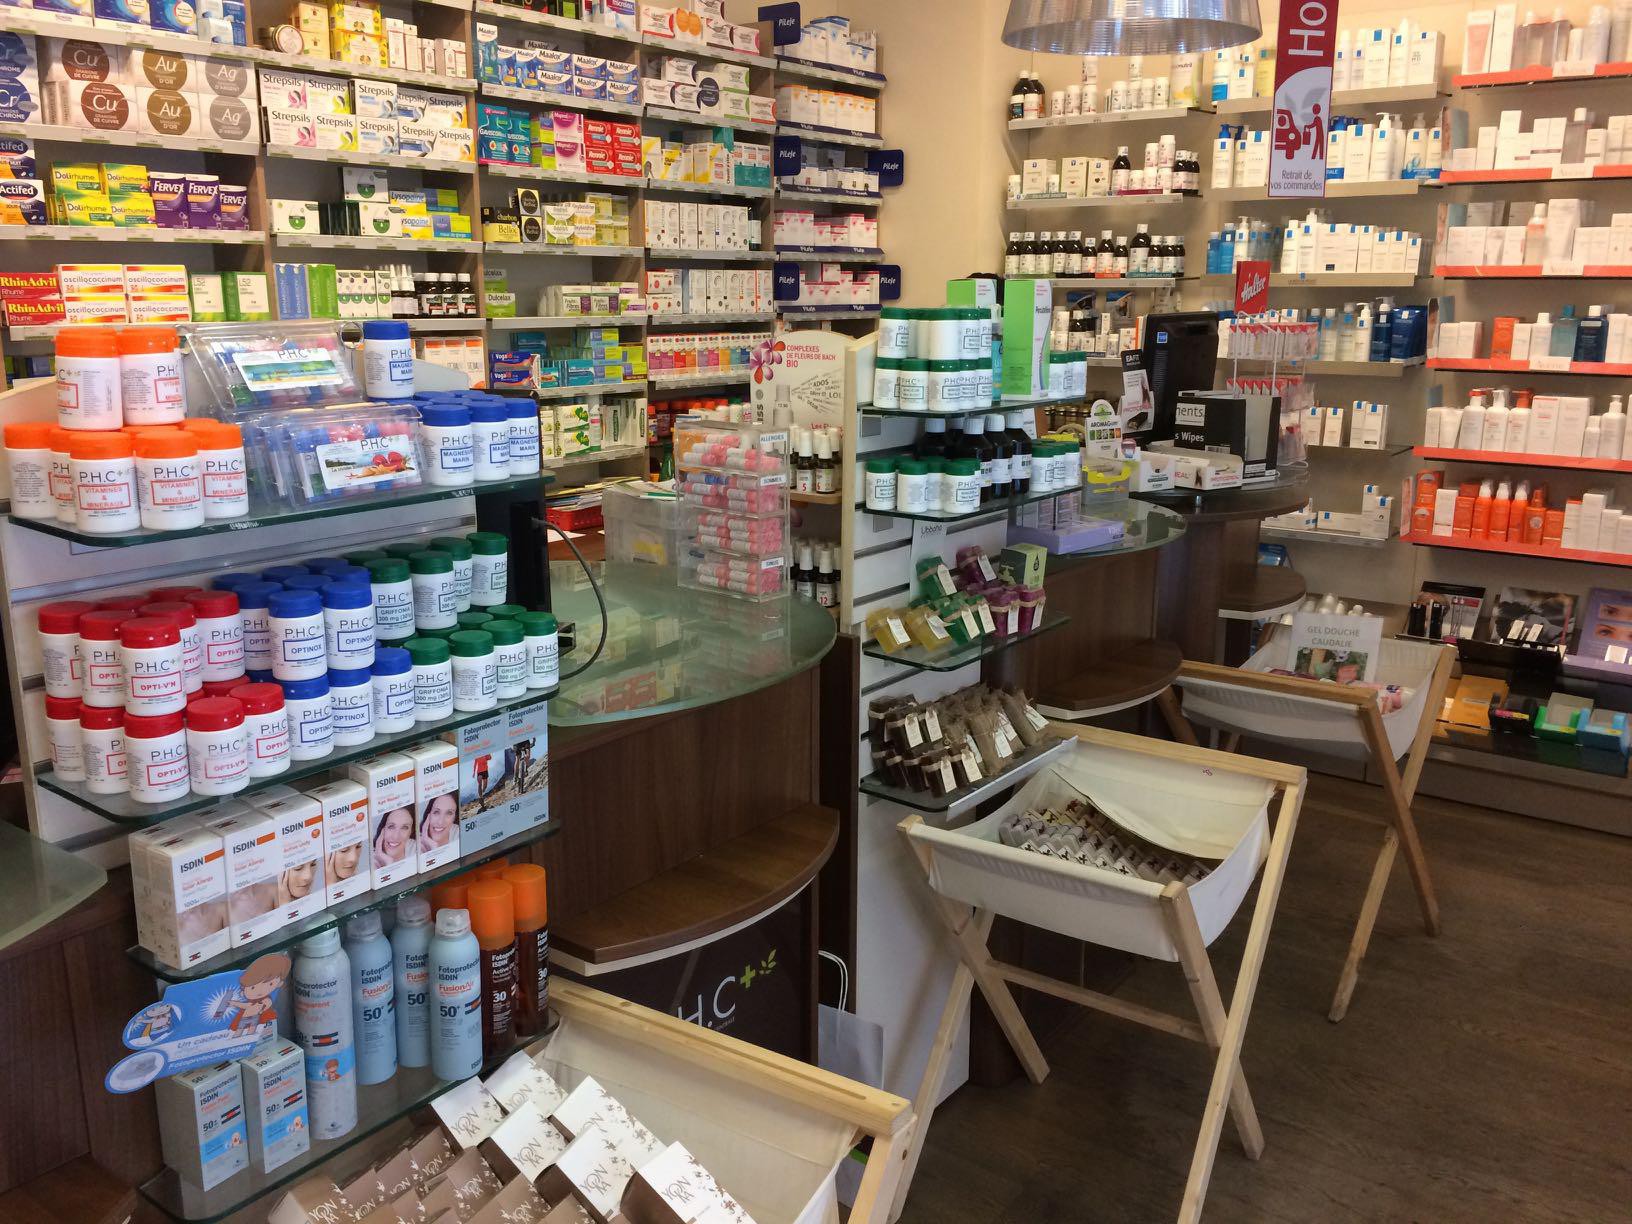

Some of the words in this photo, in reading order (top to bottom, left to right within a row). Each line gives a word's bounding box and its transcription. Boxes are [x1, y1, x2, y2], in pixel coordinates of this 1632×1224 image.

[527, 41, 549, 49] Maalox
[74, 50, 98, 66] Cu
[517, 49, 535, 58] Maalox
[538, 49, 562, 61] Maalox
[155, 56, 176, 72] Au
[576, 56, 599, 67] Maalox
[608, 61, 630, 72] Maalox
[218, 66, 237, 81] Ag
[540, 71, 563, 82] Maalox
[263, 74, 301, 87] Strepsils
[308, 79, 346, 92] Strepsils
[576, 77, 599, 88] Maalox
[358, 84, 394, 97] Strepsils
[609, 82, 630, 92] Maalox
[93, 95, 117, 111] Cu
[428, 96, 463, 108] Strepsils
[160, 102, 180, 117] Au
[222, 111, 240, 126] Ag
[272, 110, 311, 123] Strepsils
[316, 115, 353, 128] Strepsils
[360, 120, 395, 132] Strepsils
[402, 125, 435, 137] Strepsils
[438, 129, 471, 141] Strepsils
[1282, 170, 1302, 179] Retrait
[1304, 169, 1312, 179] de
[0, 185, 34, 195] Actifed
[153, 181, 184, 194] FERVEX
[188, 182, 219, 196] FERVEX
[1271, 182, 1281, 190] vos
[1284, 181, 1322, 190] commandes
[219, 193, 247, 206] FERVEX
[0, 277, 57, 288] RhinAdvil
[1, 288, 24, 296] Rhume
[8, 303, 64, 314] RhinAdvil
[786, 345, 819, 353] COMPLEXES
[1181, 431, 1204, 442] Wipes
[80, 470, 116, 482] P.H.C
[160, 481, 195, 489] VITAMINES
[162, 495, 197, 503] MINERAUX
[1307, 625, 1325, 636] GEL
[1328, 626, 1360, 638] DOUCHE
[1311, 637, 1352, 649] CAUDALIE
[291, 645, 322, 654] OPTINOX
[135, 660, 170, 672] P.H.C
[419, 686, 448, 695] GRIFFONIA
[334, 713, 365, 721] OPTINOX
[509, 704, 544, 720] Fotoprotector
[464, 719, 501, 736] Fotoprotector
[509, 719, 523, 727] ISDIN
[464, 734, 479, 744] ISDIN
[424, 763, 442, 775] ISDIN
[376, 776, 396, 788] ISDIN
[329, 805, 350, 818] ISDIN
[534, 813, 546, 822] ISDIN
[282, 821, 303, 835] ISDIN
[491, 831, 503, 840] ISDIN
[233, 840, 256, 854] ISDIN
[180, 857, 204, 873] ISDIN
[361, 975, 382, 984] ISDIN
[493, 991, 506, 1002] 30
[264, 1076, 282, 1089] ISDIN
[200, 1091, 219, 1106] ISDIN
[452, 1107, 480, 1135] YON
[516, 1138, 541, 1166] YON
[582, 1164, 608, 1193] YON
[662, 1175, 691, 1201] YON
[309, 1200, 338, 1221] YON
